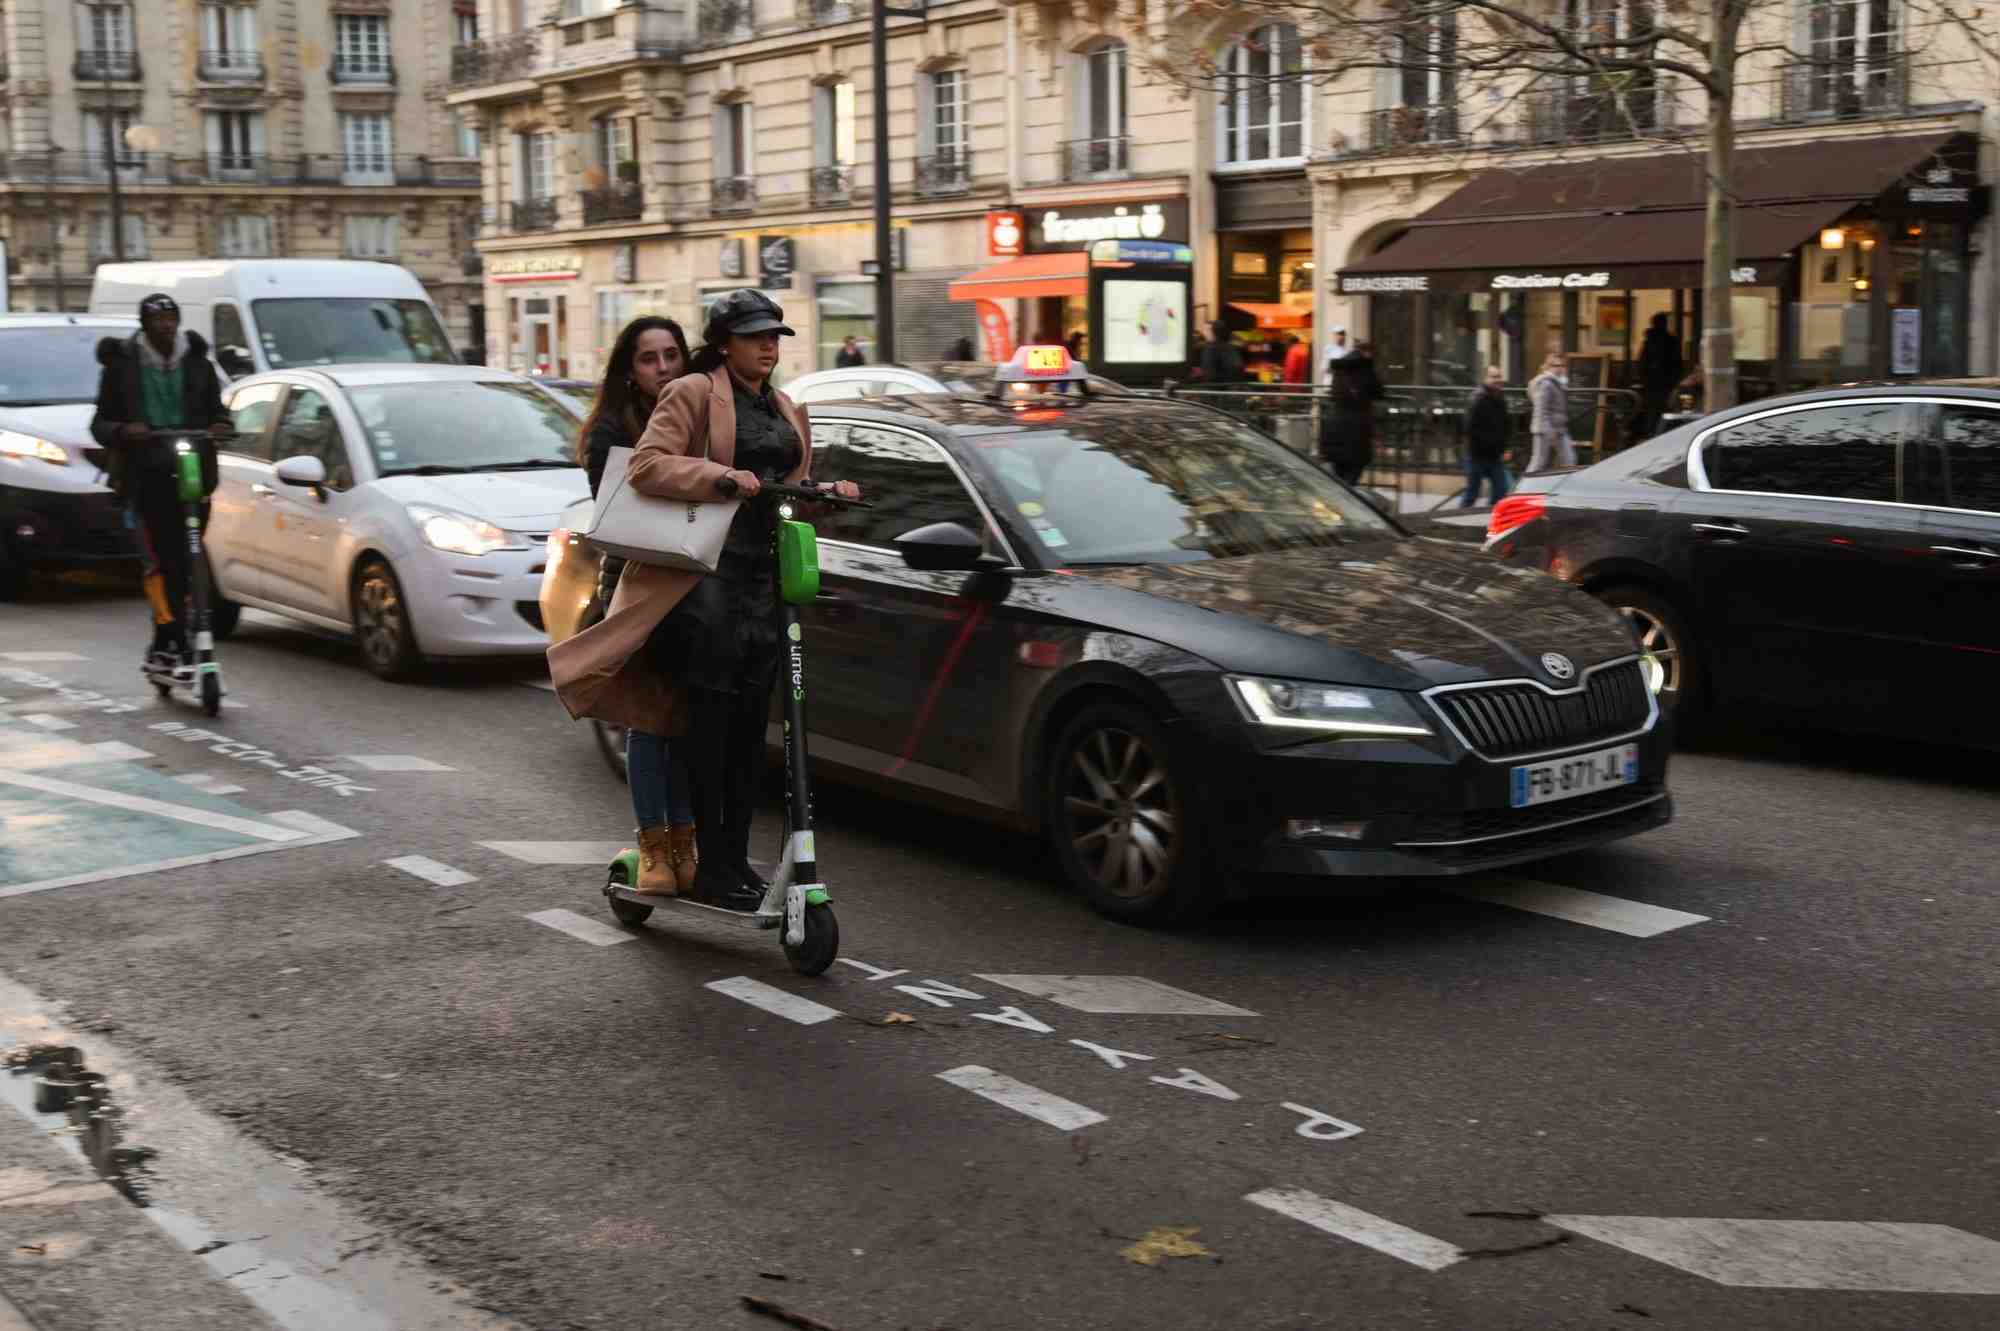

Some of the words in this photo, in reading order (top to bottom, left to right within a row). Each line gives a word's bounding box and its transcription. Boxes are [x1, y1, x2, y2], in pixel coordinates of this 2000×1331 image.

[1343, 277, 1429, 292] BRASSERIE
[1491, 275, 1562, 289] Station
[836, 957, 1366, 1141] PAYANT
